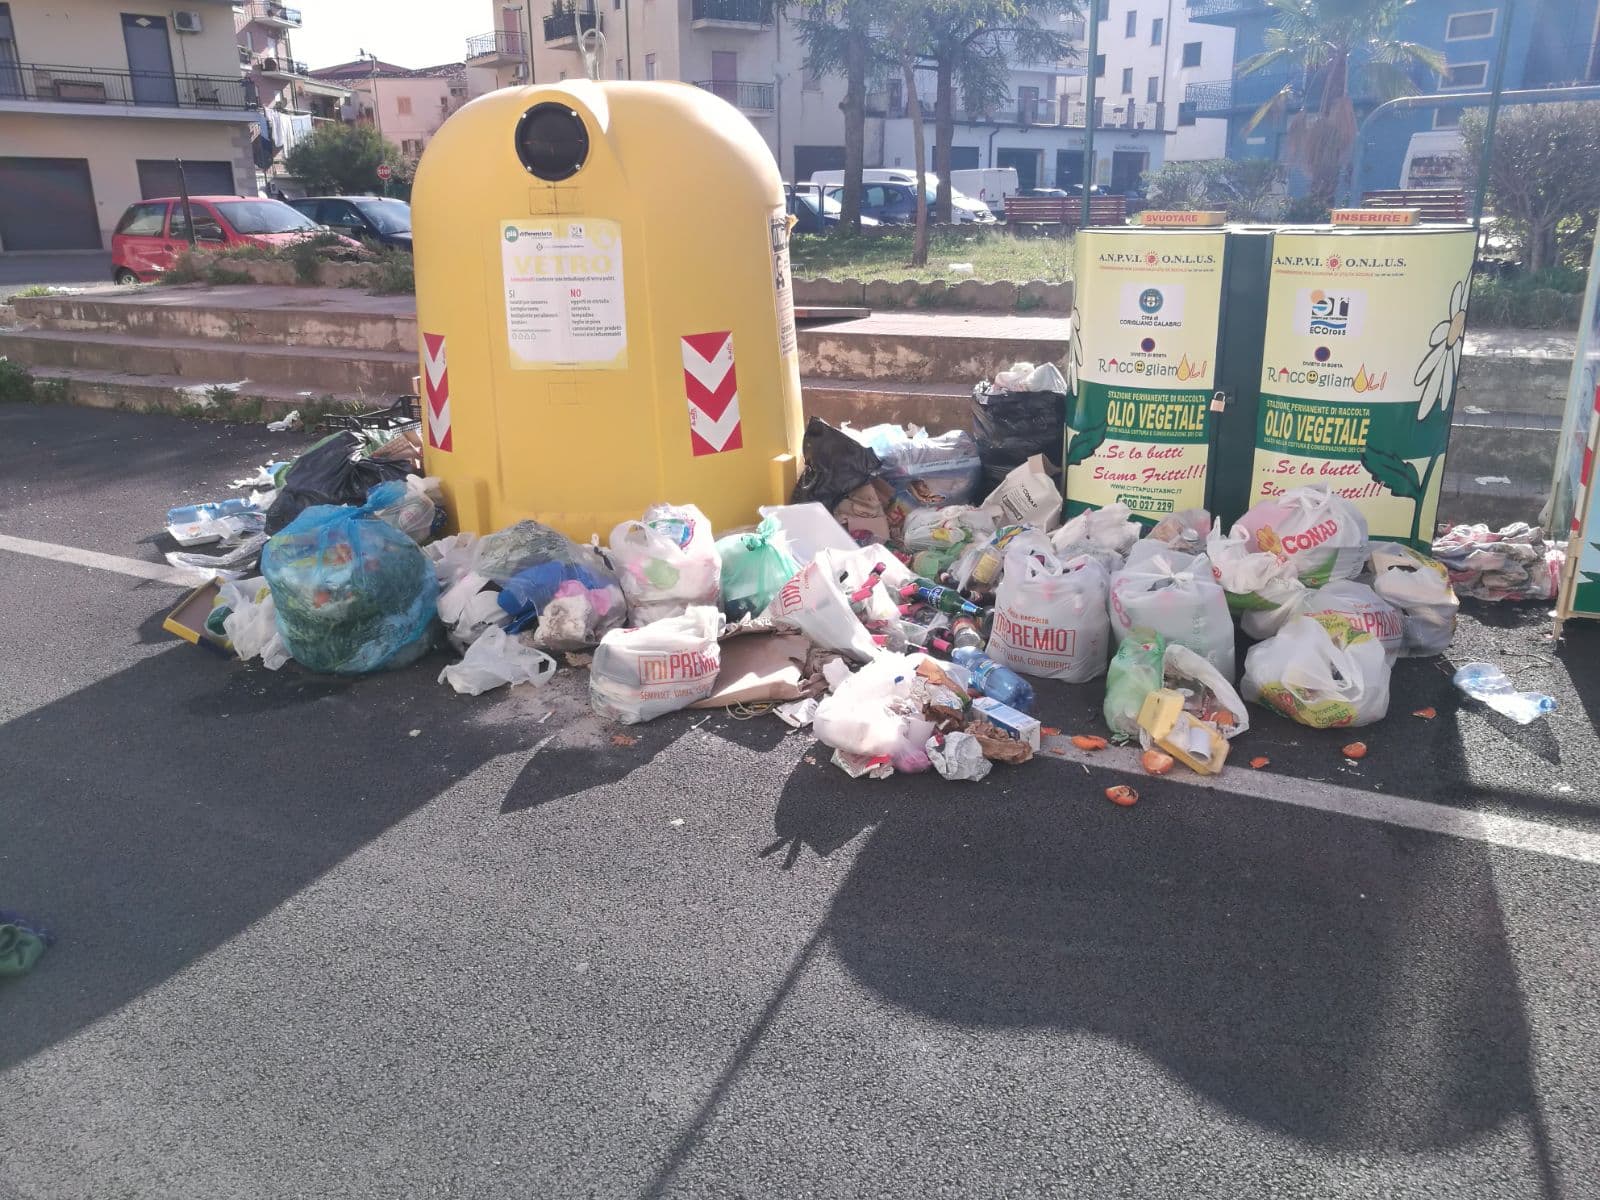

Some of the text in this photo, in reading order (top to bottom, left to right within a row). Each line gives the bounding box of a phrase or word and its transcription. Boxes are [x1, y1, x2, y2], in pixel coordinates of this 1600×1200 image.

[1146, 214, 1198, 222] SVUOTARE
[1336, 213, 1401, 222] INSERIRE
[514, 255, 612, 275] VETRO
[1099, 253, 1216, 264] A.N.P.V.I. O.N.L.U.S.
[1274, 256, 1407, 268] A.N.P.V.I. O.N.L.U.S.
[570, 289, 582, 298] NO
[1107, 390, 1132, 401] STAZIONE
[1132, 393, 1169, 402] PERMANENTE
[1107, 399, 1206, 431] OLIO VEGETALE
[1266, 400, 1370, 416] STAZIONE PERMANENTE DI RACCOLTA
[1264, 410, 1370, 445] OLIO VEGETALE
[1129, 447, 1143, 459] lo
[1147, 445, 1184, 459] butti
[1093, 464, 1206, 483] Siamo Fritti!!!
[1300, 462, 1315, 475] lo
[1320, 461, 1361, 476] butti
[1140, 500, 1154, 510] 027
[1157, 501, 1172, 511] 229
[1281, 519, 1338, 554] CONAD
